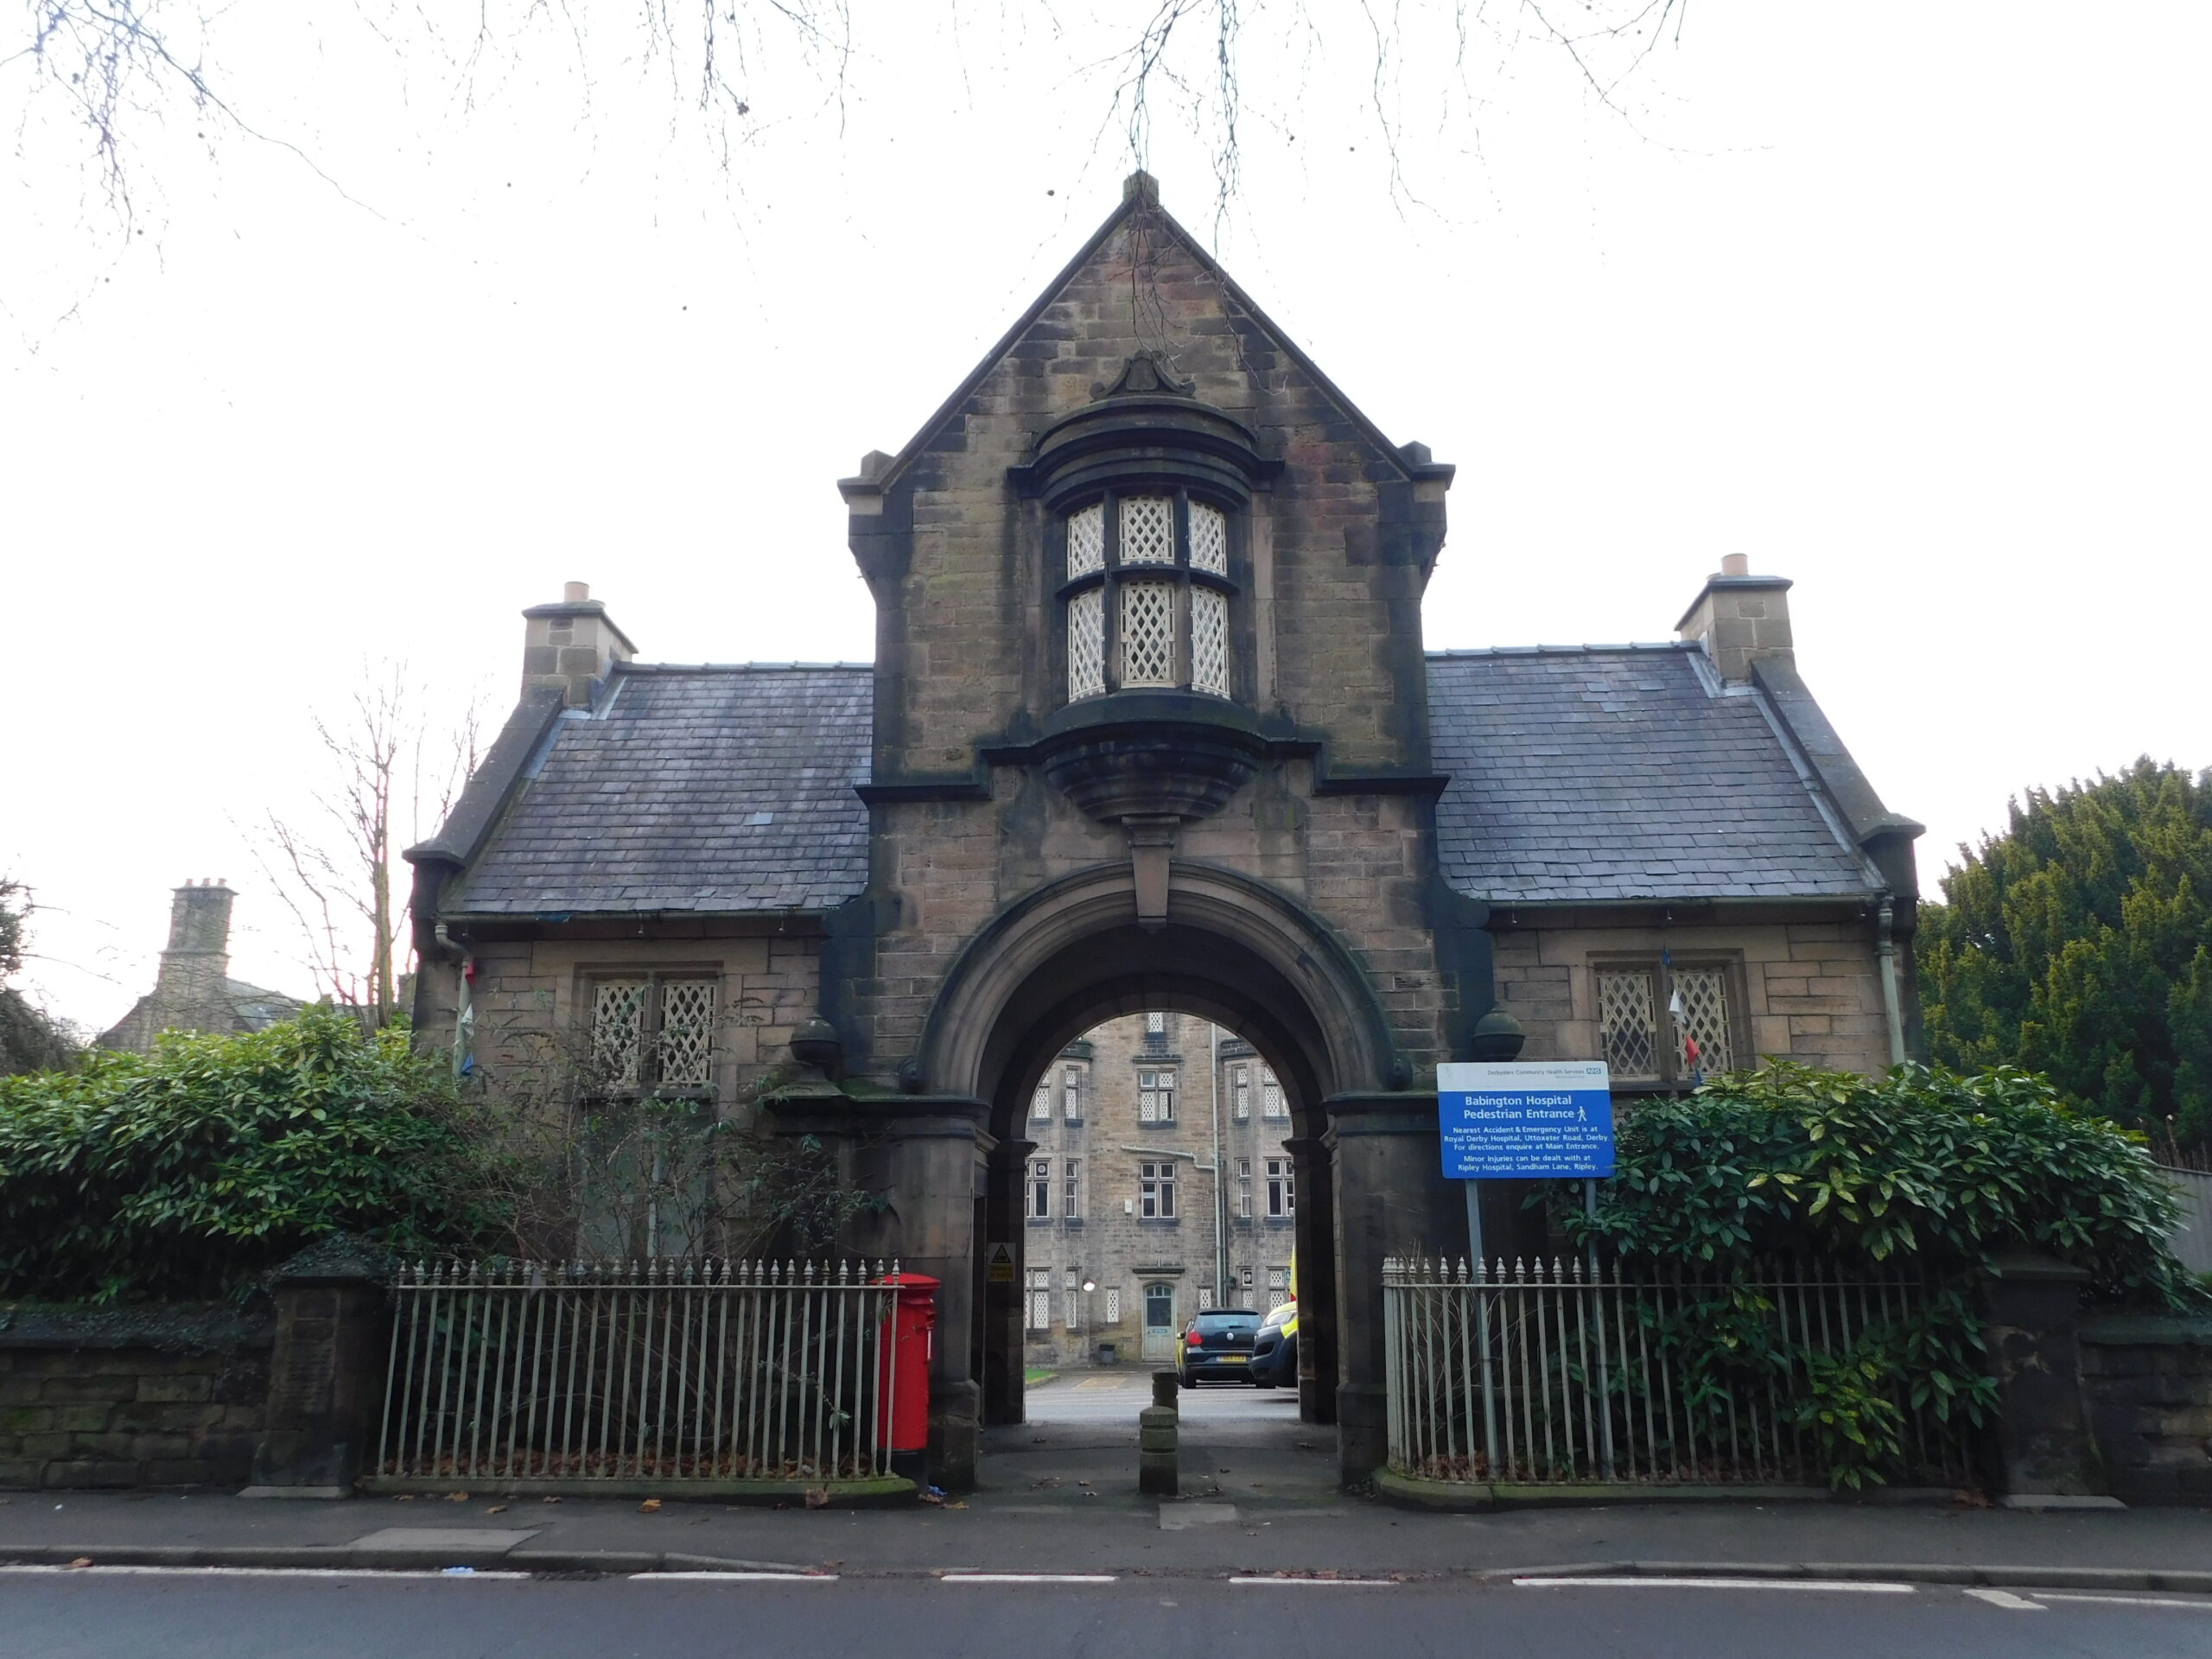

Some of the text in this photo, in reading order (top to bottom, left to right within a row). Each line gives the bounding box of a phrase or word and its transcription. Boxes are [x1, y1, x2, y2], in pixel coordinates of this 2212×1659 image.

[1465, 1095, 1572, 1108] Babington Hospital
[1464, 1109, 1574, 1119] Pedestrian Entrance
[1466, 1135, 1488, 1143] Derby
[1491, 1135, 1522, 1143] Hospital,
[1483, 1163, 1514, 1172] Hospital,
[1574, 1162, 1599, 1171] Ripley.
